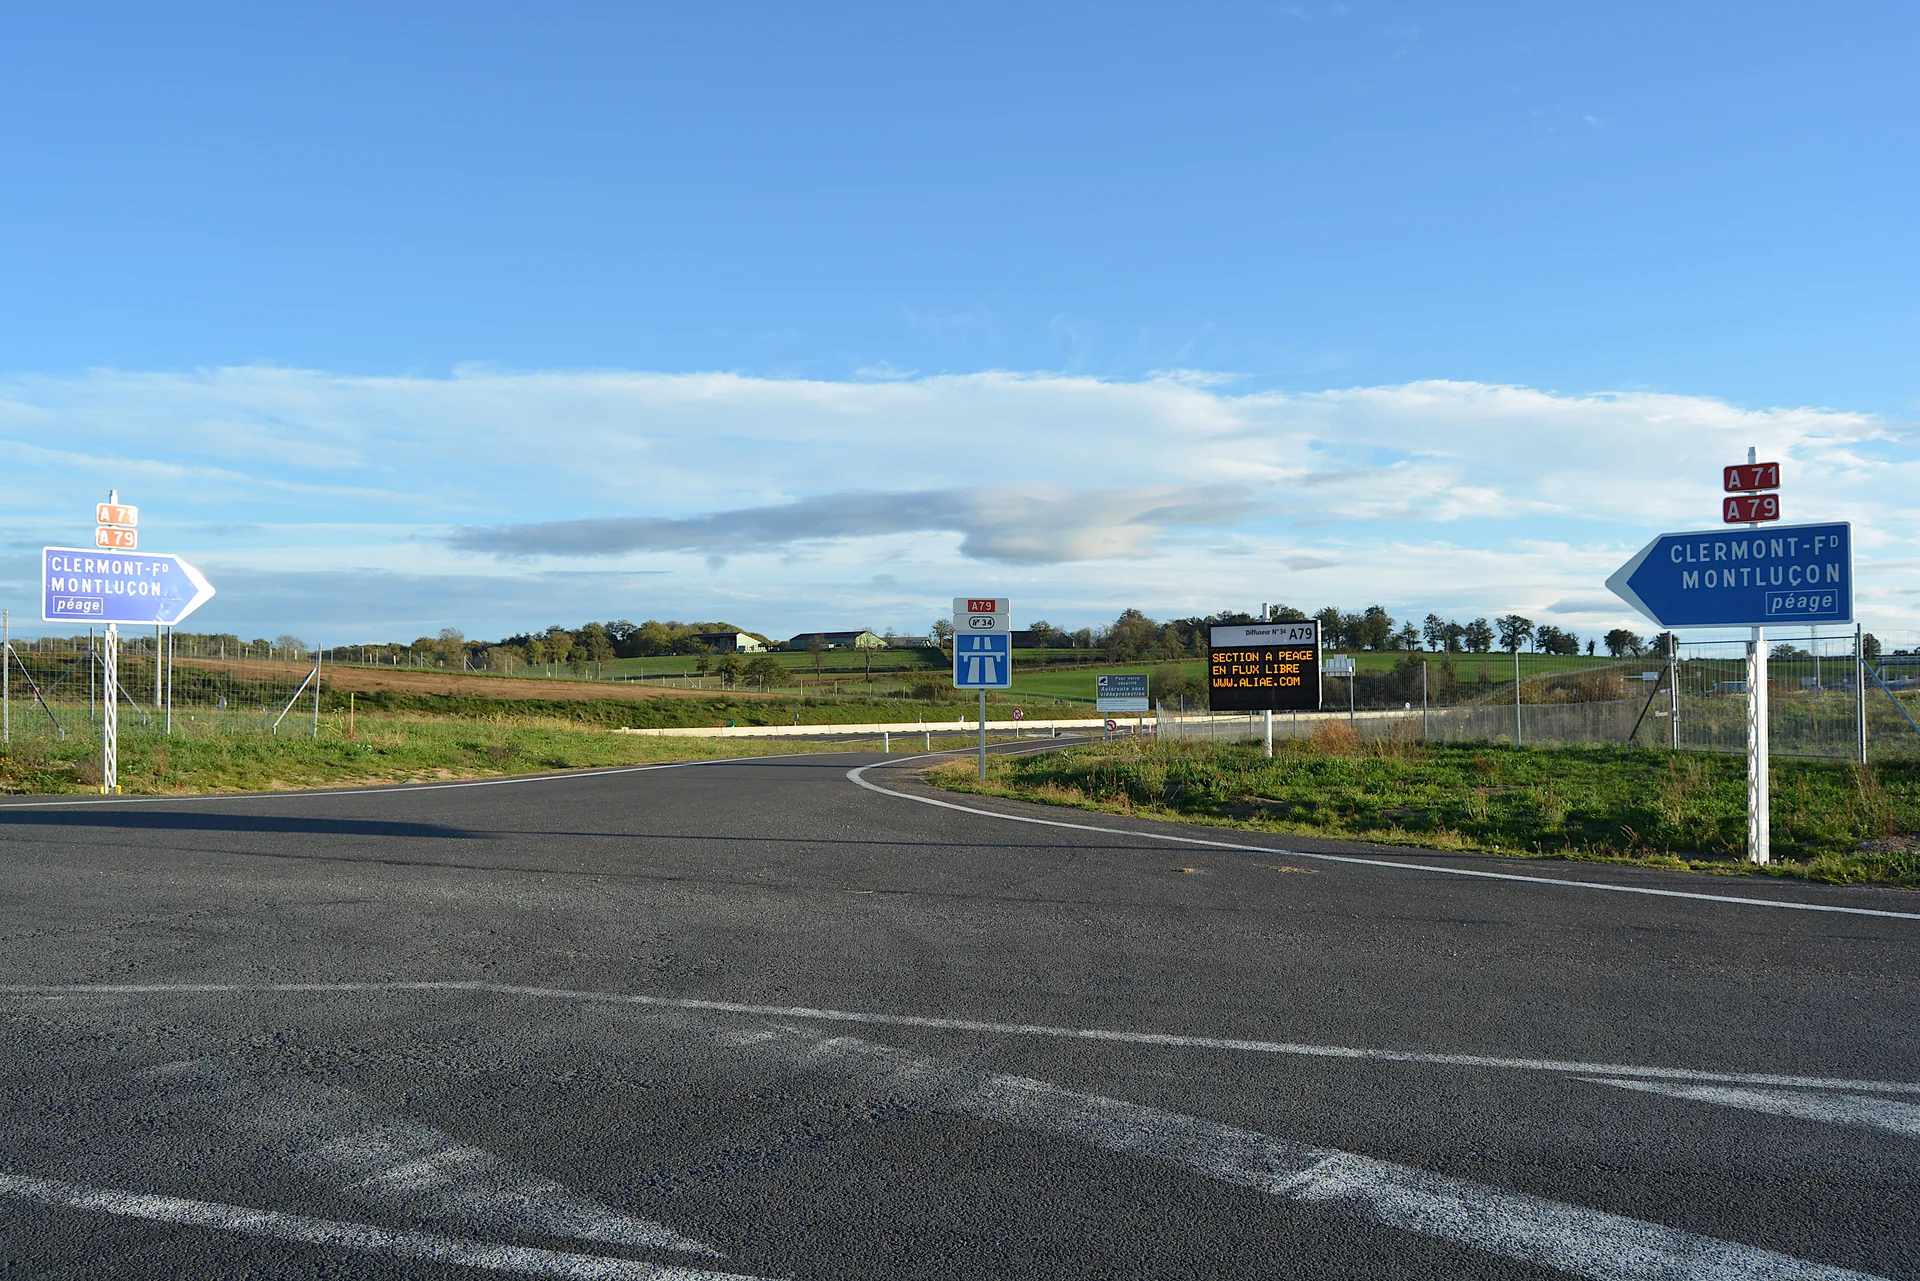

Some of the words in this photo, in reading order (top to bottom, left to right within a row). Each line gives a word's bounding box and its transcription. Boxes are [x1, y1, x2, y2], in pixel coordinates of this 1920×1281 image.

[1728, 470, 1741, 488] A
[1751, 466, 1777, 486] 71
[100, 507, 110, 521] A
[116, 508, 134, 524] 71
[1727, 501, 1740, 519] A
[1747, 498, 1776, 518] 79
[99, 531, 109, 545] A
[113, 532, 134, 547] 79
[1683, 563, 1840, 589] MONTLUÇON
[51, 577, 161, 597] MONTLUÇON
[56, 598, 100, 614] péage
[972, 602, 992, 611] A79
[1772, 593, 1833, 613] péage
[1288, 627, 1313, 640] A79
[1212, 652, 1259, 662] SECTION
[1265, 652, 1273, 661] A
[1278, 650, 1313, 661] PEAGE
[1212, 665, 1226, 675] EN
[1232, 665, 1260, 675] FLUX
[1265, 664, 1300, 674] LIBRE
[1212, 676, 1301, 688] WWW.ALIAE.COM
